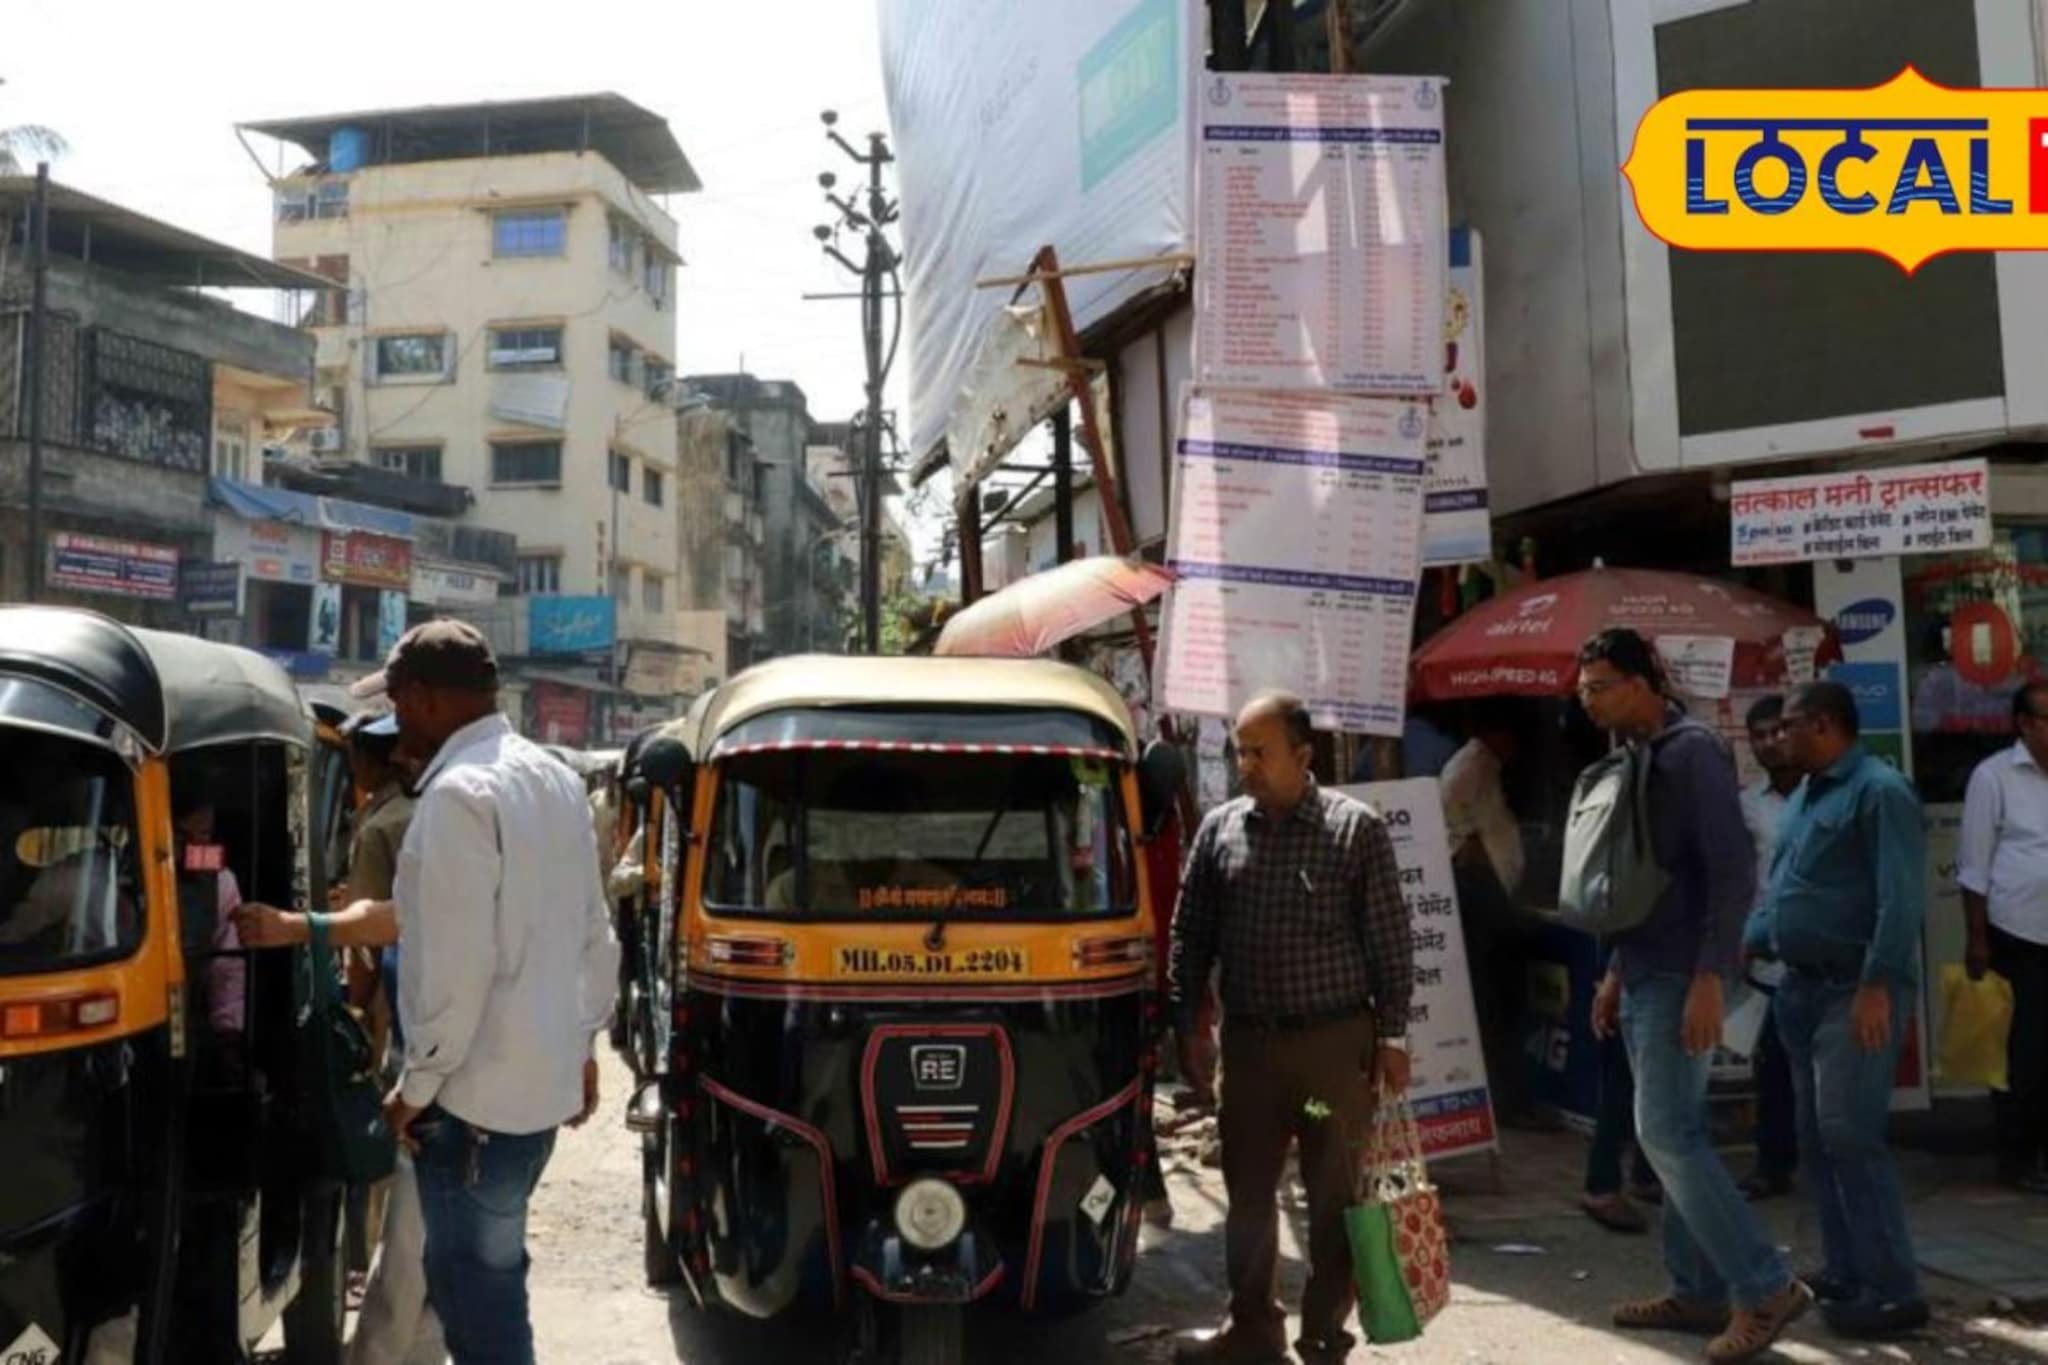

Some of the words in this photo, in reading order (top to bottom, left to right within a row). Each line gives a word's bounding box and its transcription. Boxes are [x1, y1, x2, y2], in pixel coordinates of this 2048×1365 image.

[1732, 485, 1817, 517] तत्काल
[1824, 475, 1873, 507] मनी
[1486, 616, 1554, 636] airtel
[921, 1059, 957, 1080] RE
